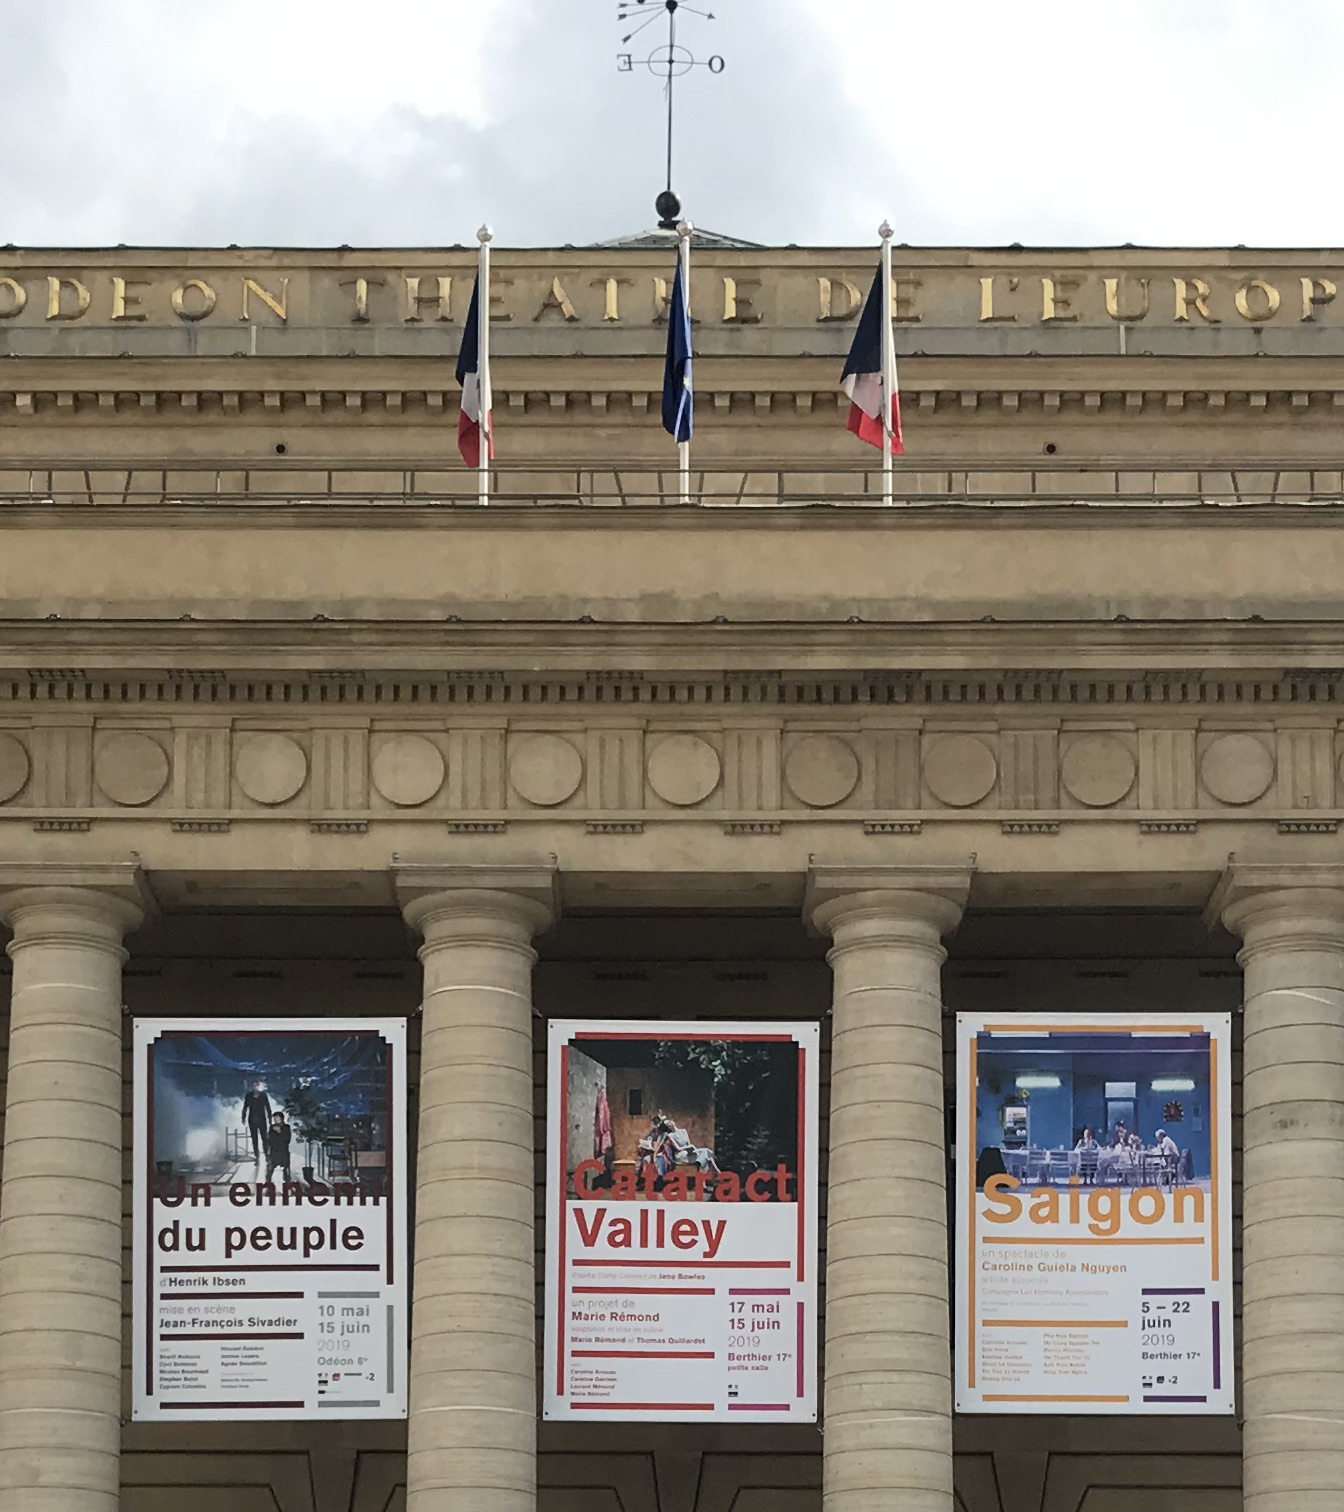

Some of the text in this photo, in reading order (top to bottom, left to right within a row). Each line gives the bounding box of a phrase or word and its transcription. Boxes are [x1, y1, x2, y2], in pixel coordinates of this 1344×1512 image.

[817, 276, 924, 323] DE
[572, 1158, 792, 1202] Cataract
[159, 1176, 380, 1208] Un ennemi
[981, 1173, 1205, 1236] Saigon
[158, 1219, 365, 1259] du peuple
[572, 1208, 728, 1259] Valley
[982, 1261, 1034, 1272] Caroline
[1081, 1263, 1127, 1274] Nguyen
[212, 1277, 246, 1287] Ibsen
[159, 1305, 184, 1314] mise
[187, 1306, 200, 1314] en
[318, 1305, 369, 1316] 10 mai
[571, 1299, 635, 1310] un projet de
[729, 1301, 779, 1313] 17 mai
[1141, 1302, 1150, 1313] 5
[1172, 1301, 1190, 1313] 22
[571, 1312, 660, 1322] Marie Rémond
[159, 1318, 298, 1329] Jean-François Sivadier
[318, 1321, 370, 1336] 15 juin
[729, 1318, 780, 1332] 15 juin
[1141, 1316, 1171, 1331] juin
[317, 1340, 350, 1351] 2019
[728, 1336, 760, 1347] 2019
[1142, 1334, 1175, 1346] 2019
[317, 1357, 354, 1365] Odéon
[728, 1353, 772, 1361] Berthier
[1142, 1352, 1182, 1360] Berthier
